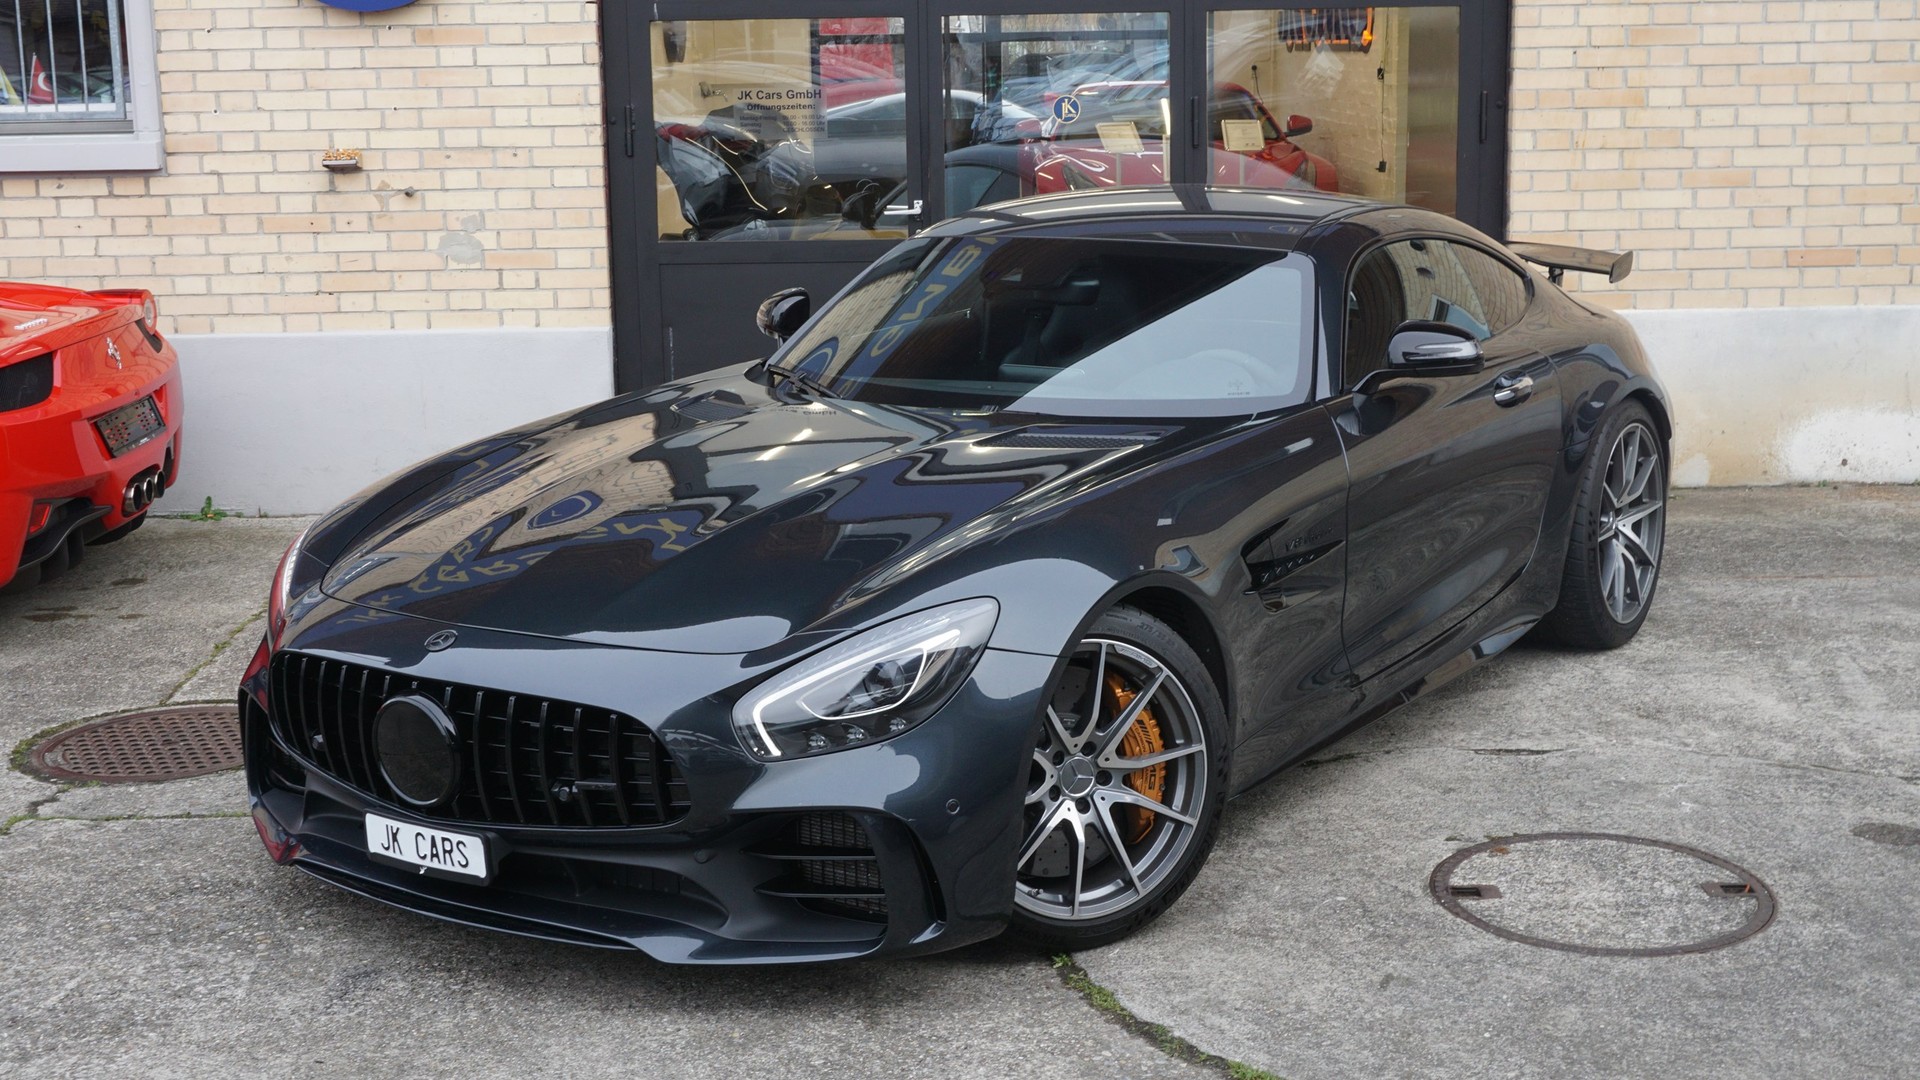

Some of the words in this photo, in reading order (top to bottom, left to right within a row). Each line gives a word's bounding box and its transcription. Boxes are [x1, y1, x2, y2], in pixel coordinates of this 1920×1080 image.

[737, 90, 753, 100] JK
[756, 90, 782, 99] Cars
[786, 89, 822, 99] GmbH
[746, 103, 816, 111] Öffnungszeiten:
[381, 824, 403, 855] JK
[415, 832, 469, 868] CARS
